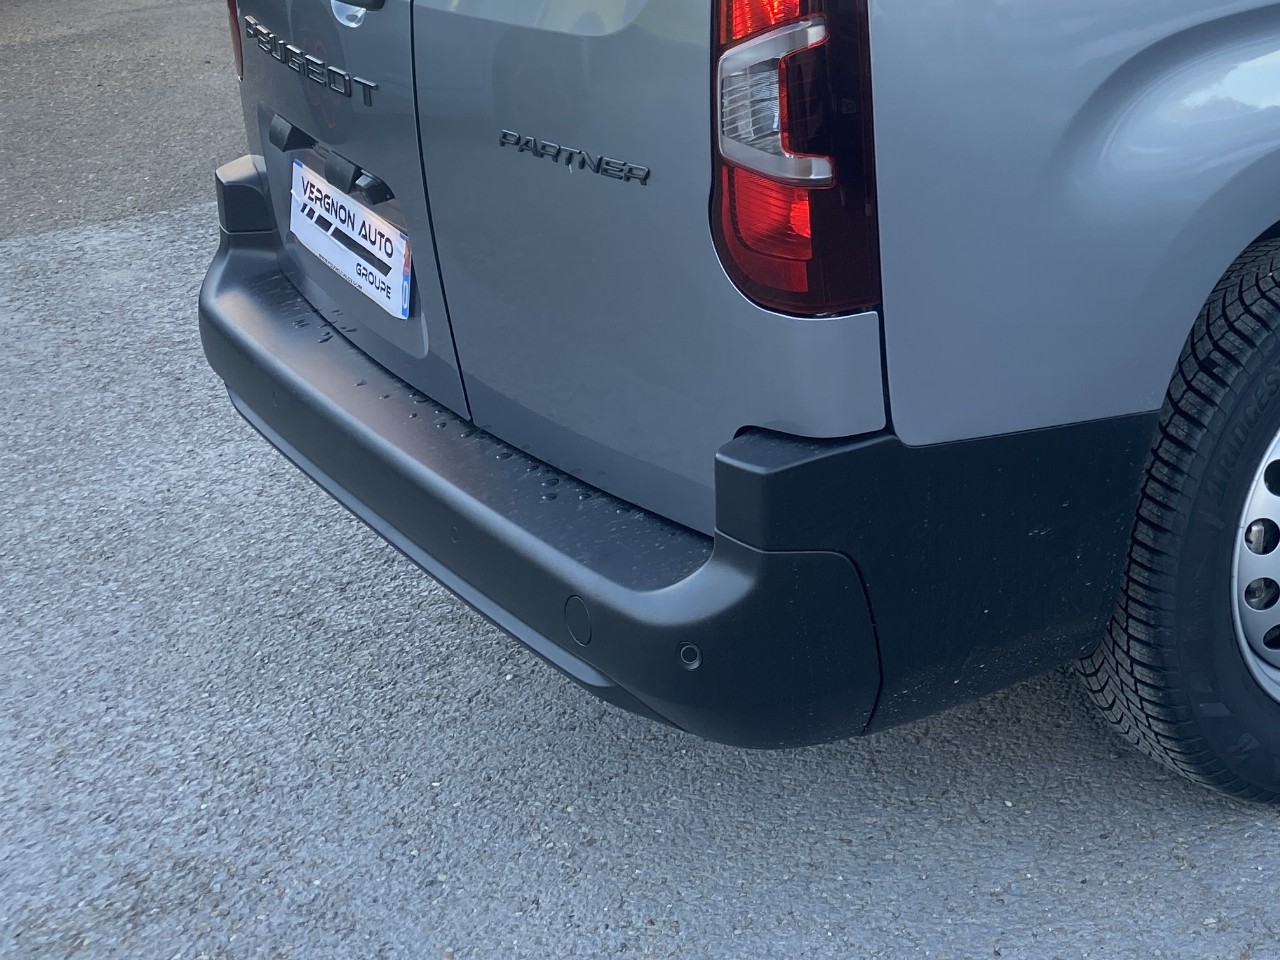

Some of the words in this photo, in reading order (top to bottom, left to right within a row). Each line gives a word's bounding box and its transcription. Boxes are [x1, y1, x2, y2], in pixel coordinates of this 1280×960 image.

[244, 15, 379, 107] PEUGEOT
[498, 128, 652, 187] PARTNER
[301, 175, 357, 232] VERGNON
[358, 218, 394, 259] AUTO
[355, 261, 393, 301] GROUPE
